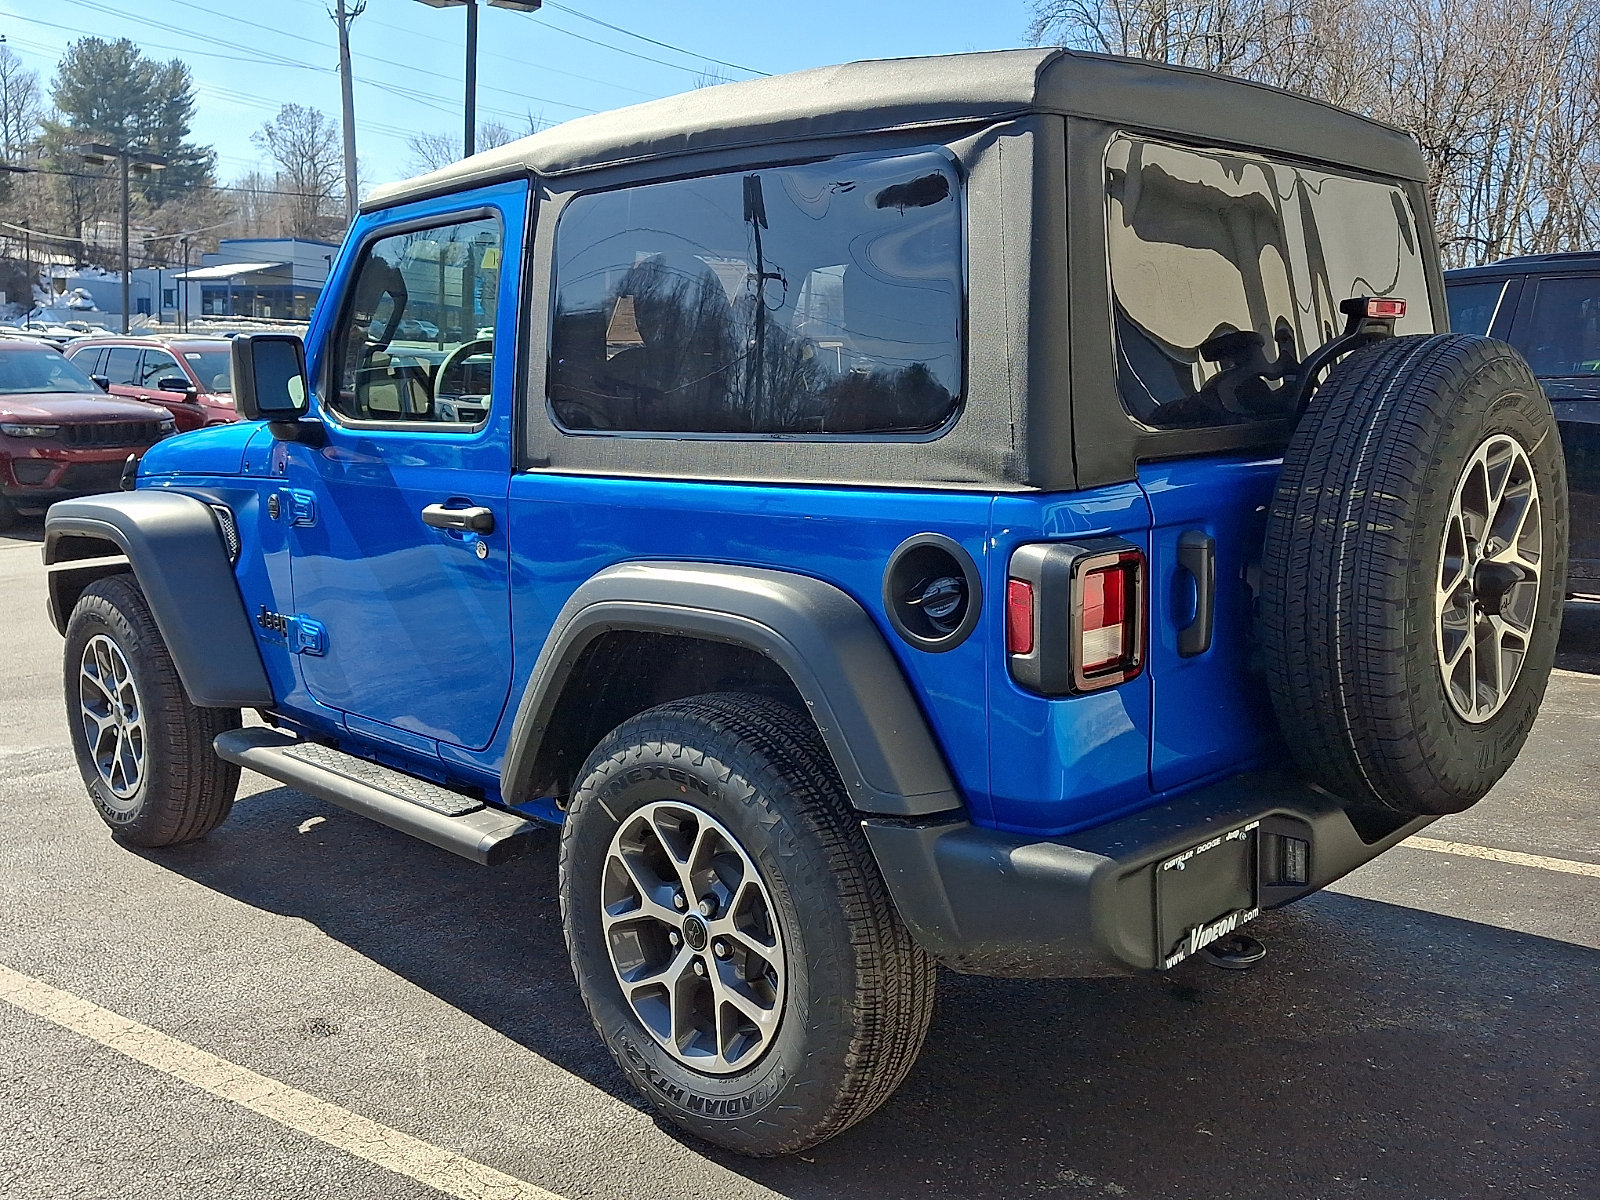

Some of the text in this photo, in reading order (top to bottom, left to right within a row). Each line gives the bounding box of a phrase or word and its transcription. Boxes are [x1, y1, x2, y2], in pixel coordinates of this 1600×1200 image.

[256, 604, 288, 637] Jeep
[609, 766, 709, 796] NEXEN
[1196, 837, 1222, 855] DODGE
[1191, 914, 1237, 954] VIDEON
[686, 1070, 779, 1117] ROADIAN
